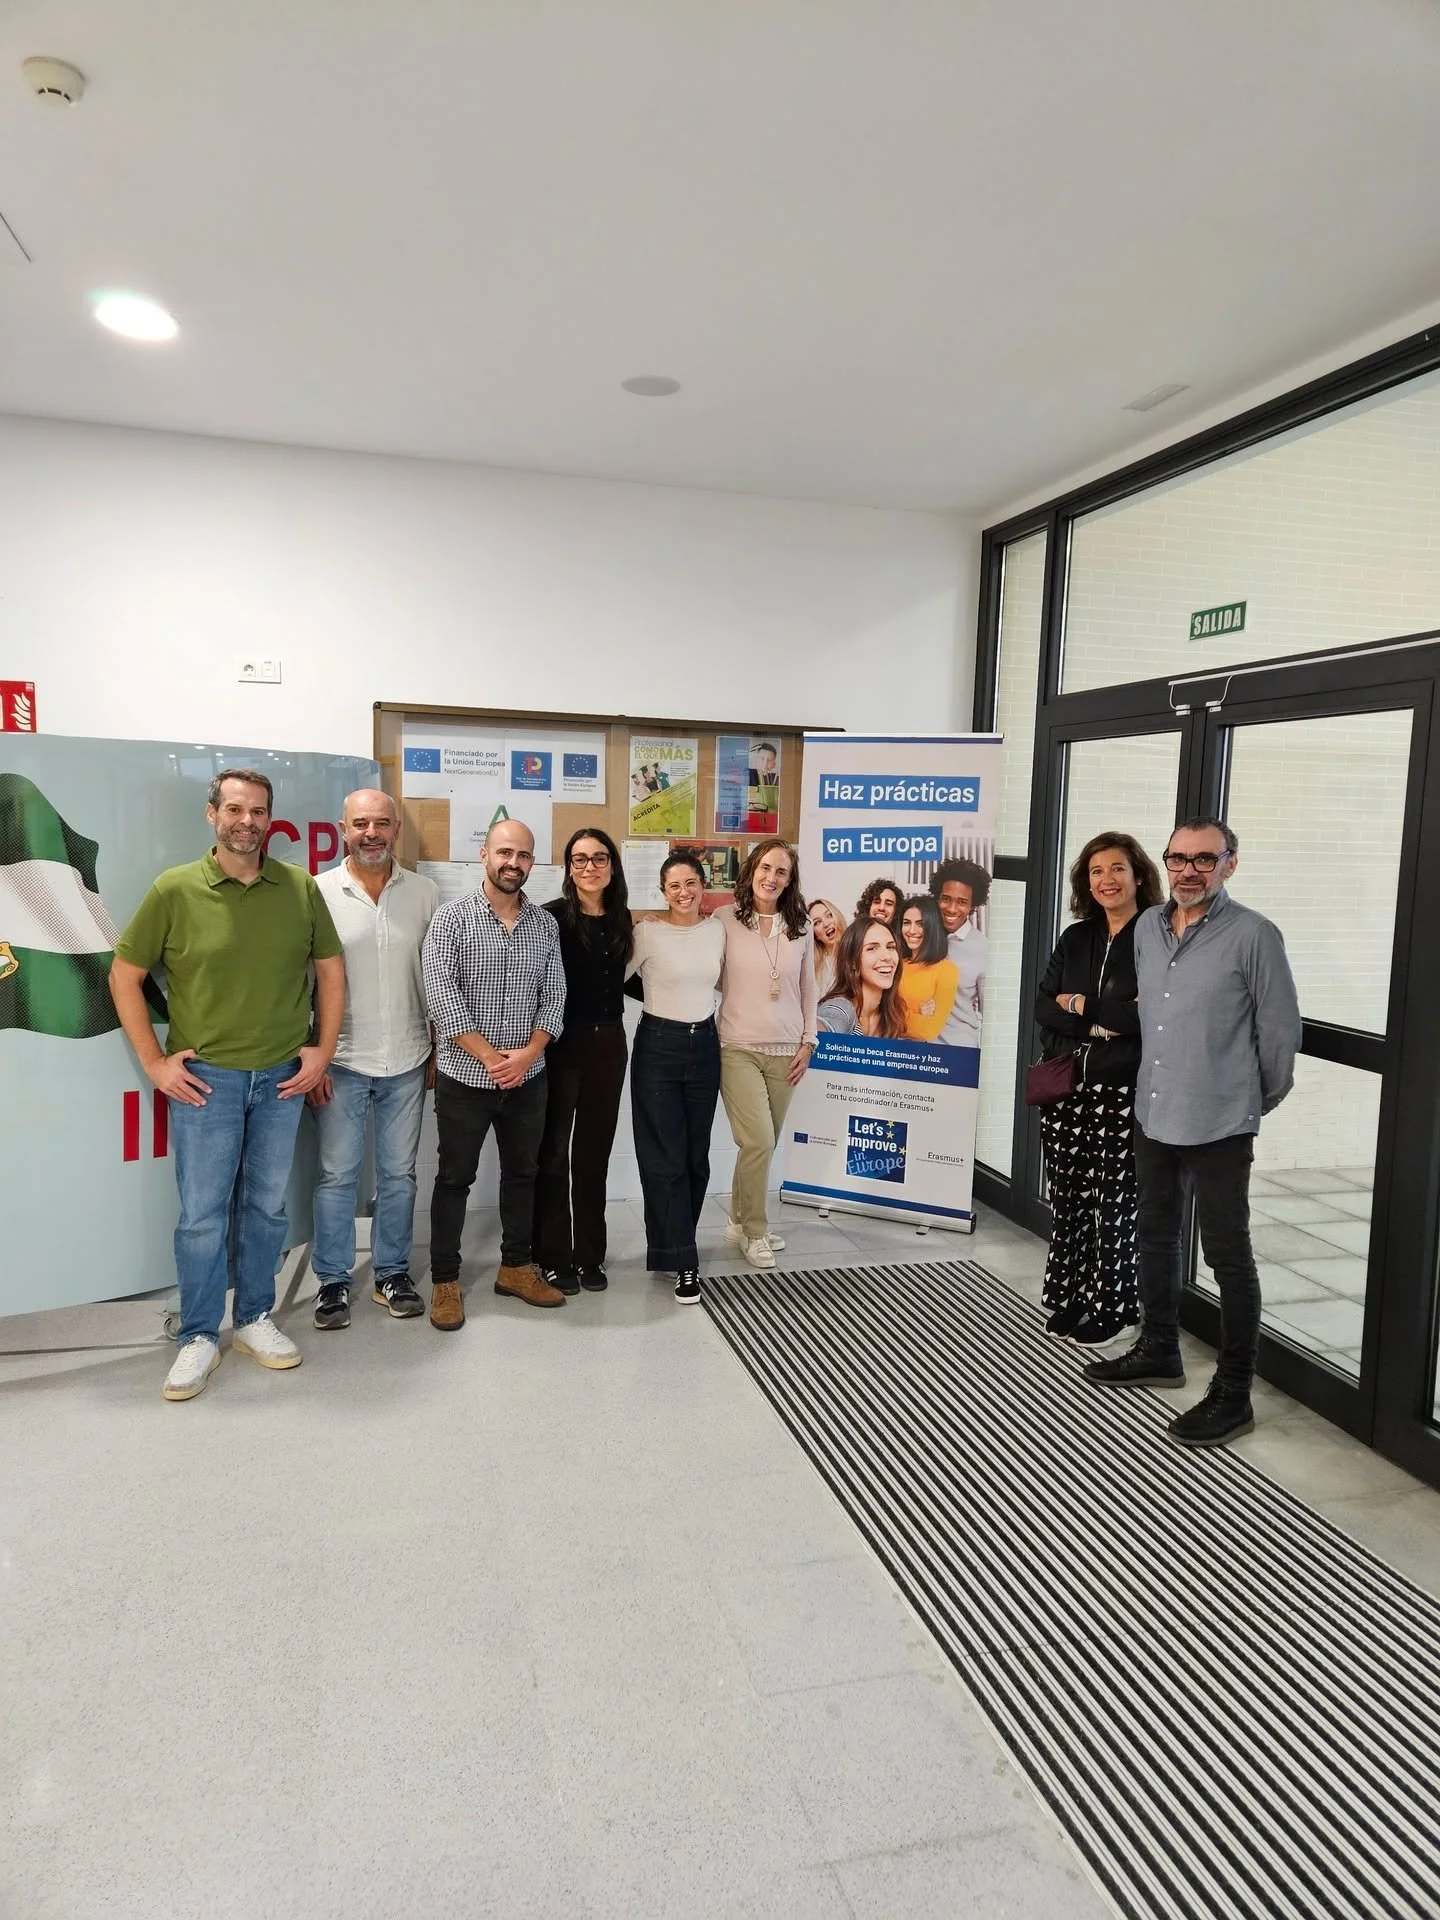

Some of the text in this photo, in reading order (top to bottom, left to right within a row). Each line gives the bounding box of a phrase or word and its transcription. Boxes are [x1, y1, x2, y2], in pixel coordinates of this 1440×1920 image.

[1193, 607, 1241, 635] SALIDA
[444, 749, 484, 757] Financiado
[660, 744, 693, 760] MÁS
[475, 759, 506, 767] Europea
[824, 780, 975, 806] Haz prácticas
[633, 803, 661, 821] ACREDITA
[826, 833, 938, 858] en Europa
[825, 1043, 941, 1063] Solicita una beca Erasmus+ y haz
[817, 1052, 949, 1075] tus prácticas en una empresa europea
[826, 1082, 935, 1103] Para más información, contacta
[848, 1095, 898, 1108] coordinador/a
[899, 1101, 934, 1112] Erasmus+
[854, 1119, 884, 1136] Let's
[847, 1133, 897, 1153] improve
[853, 1150, 867, 1161] in
[927, 1151, 965, 1164] Erasmus+
[847, 1156, 906, 1175] Europe
